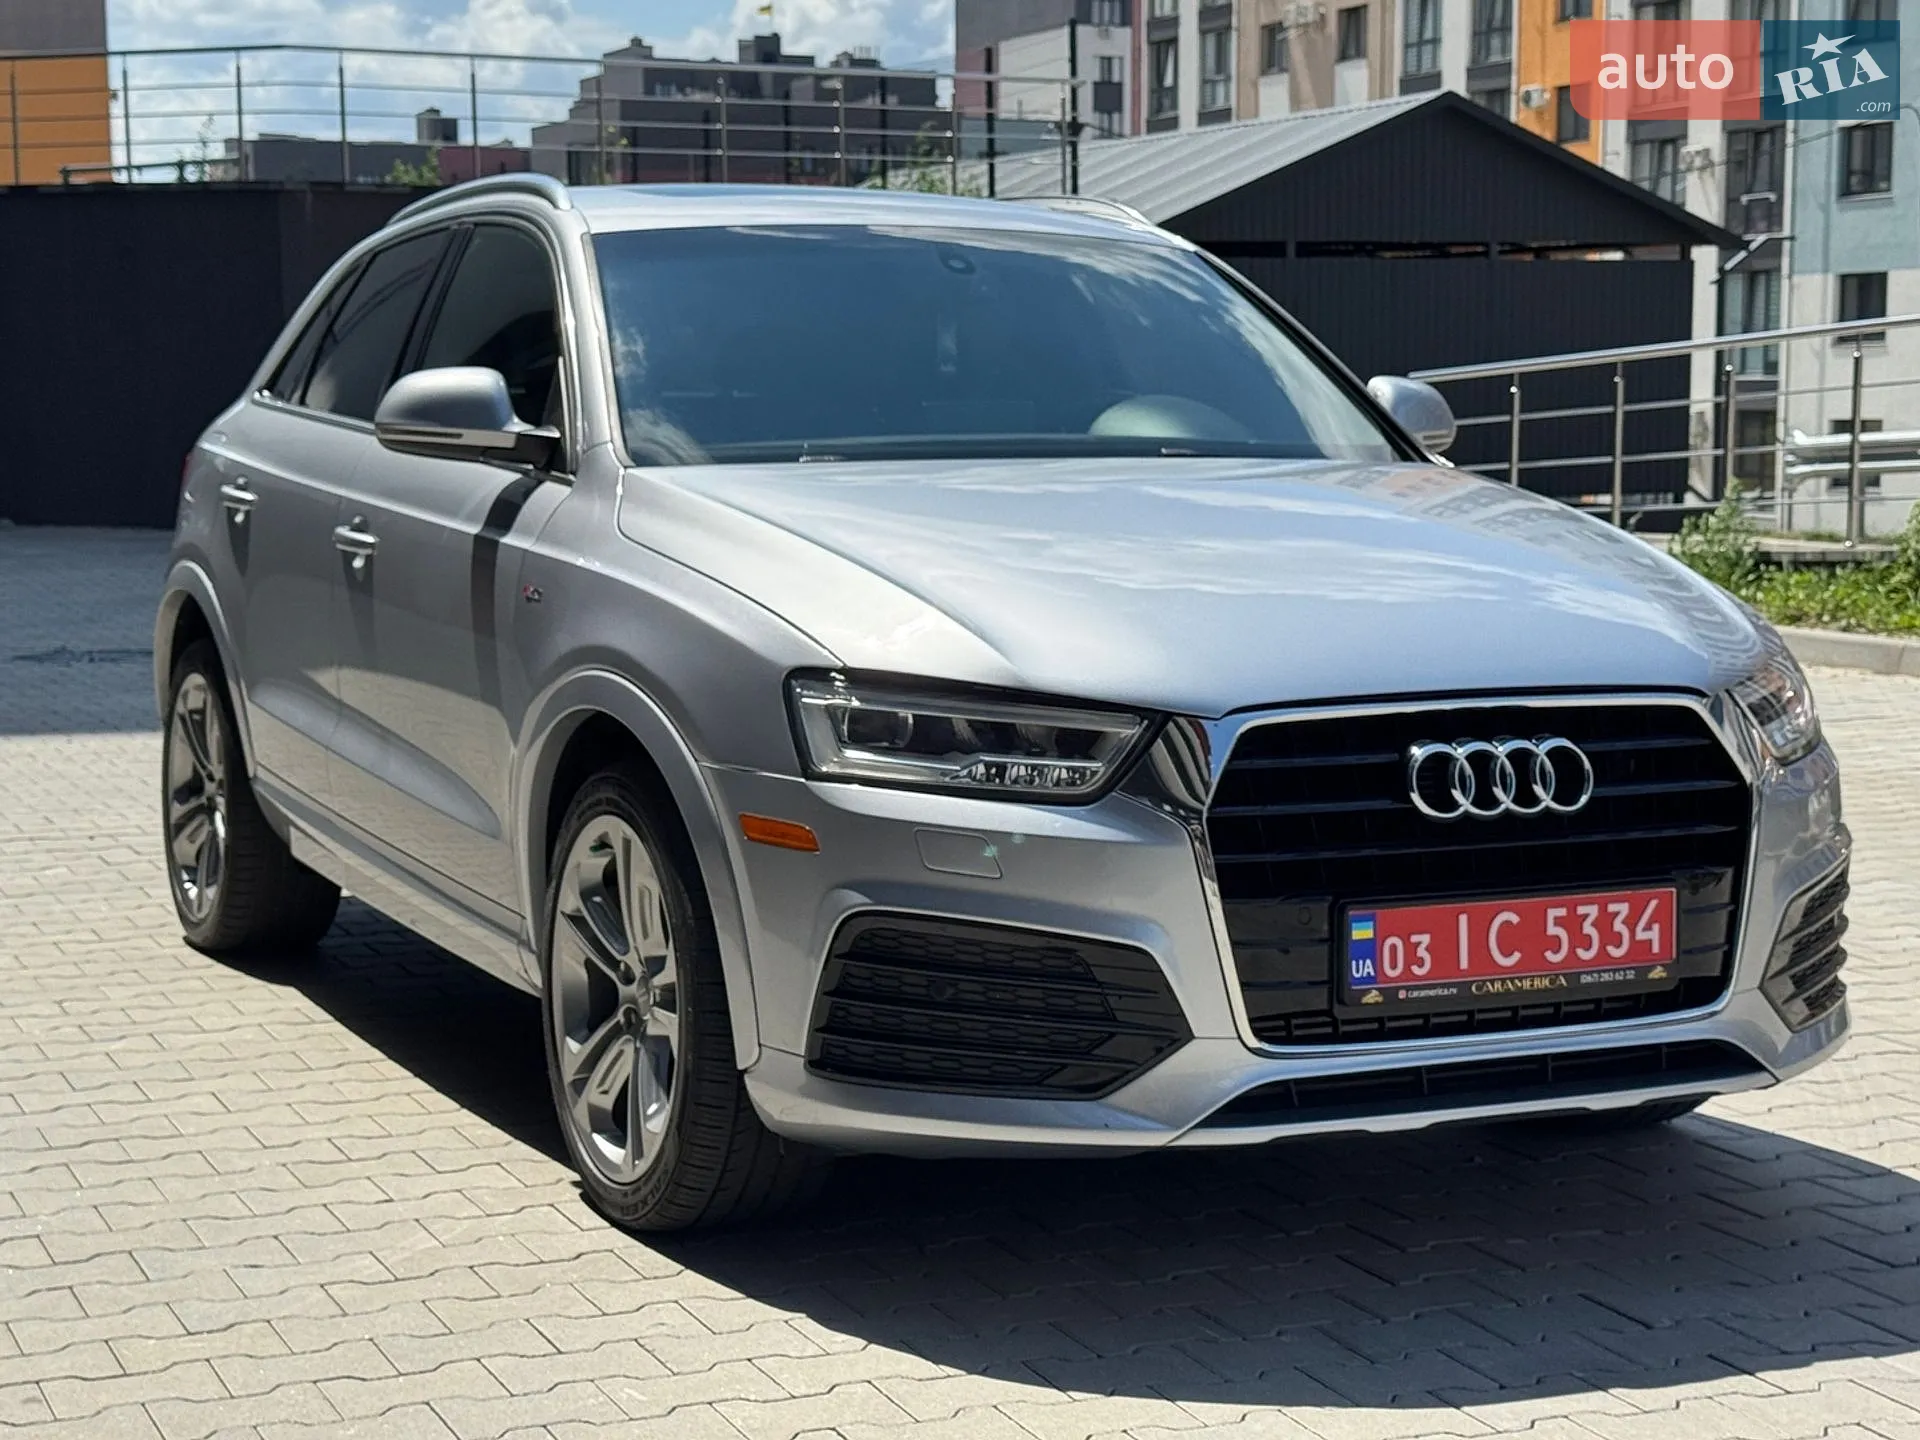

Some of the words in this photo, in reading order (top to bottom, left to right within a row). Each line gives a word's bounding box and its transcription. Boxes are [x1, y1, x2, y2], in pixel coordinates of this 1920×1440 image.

[1382, 933, 1432, 978] 03
[1543, 898, 1661, 963] 5334
[1351, 959, 1375, 978] UA
[1471, 974, 1568, 995] CARAMERICA
